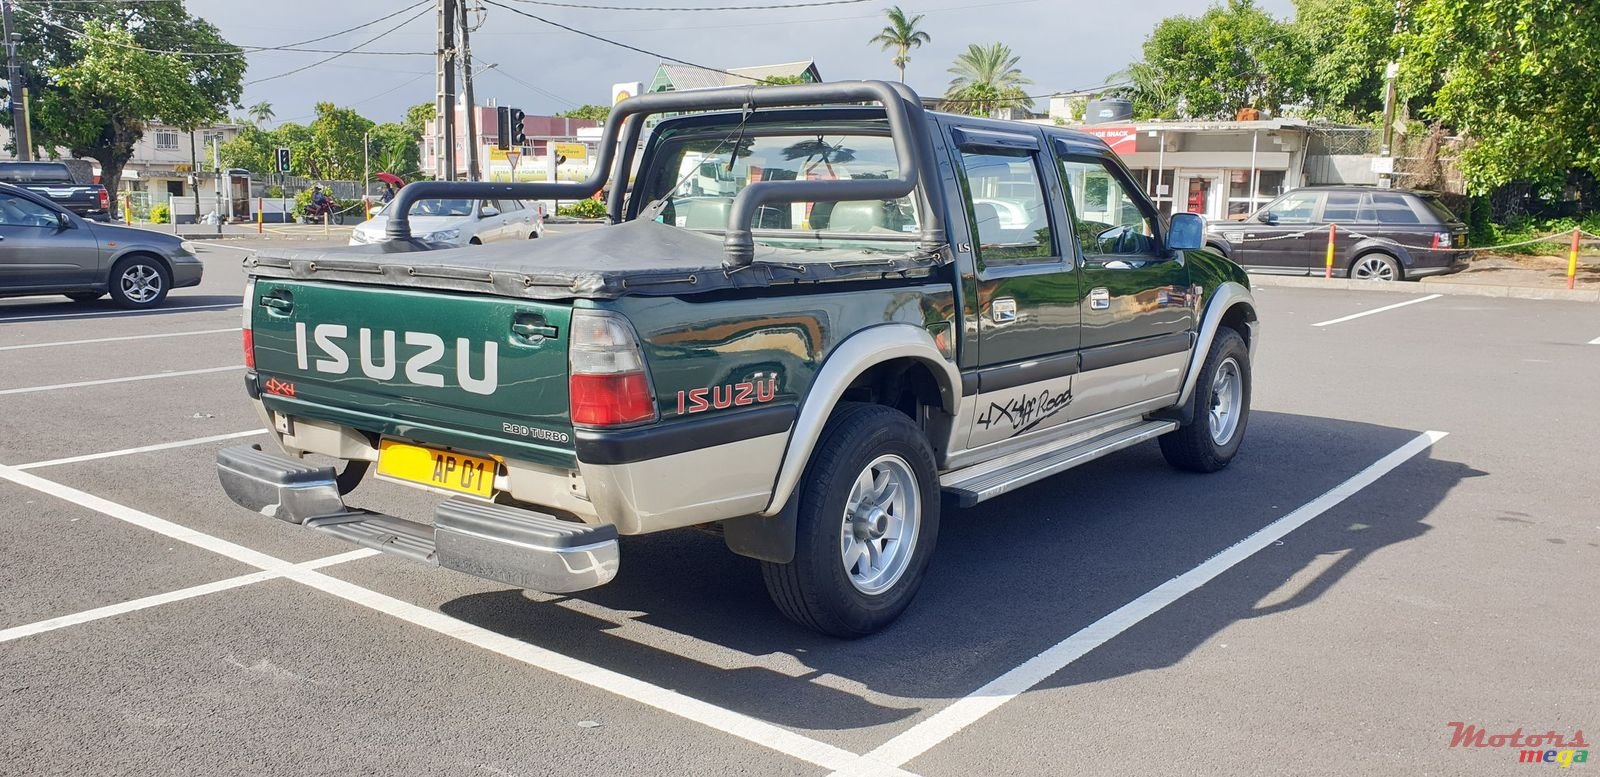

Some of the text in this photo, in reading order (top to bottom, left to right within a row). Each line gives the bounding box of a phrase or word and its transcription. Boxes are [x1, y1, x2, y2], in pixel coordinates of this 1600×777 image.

[957, 243, 970, 254] LS
[295, 321, 500, 396] ISUZU
[677, 378, 775, 415] ISUZU
[1036, 376, 1074, 418] Road
[530, 427, 569, 443] TURBO
[432, 454, 485, 491] AP 01
